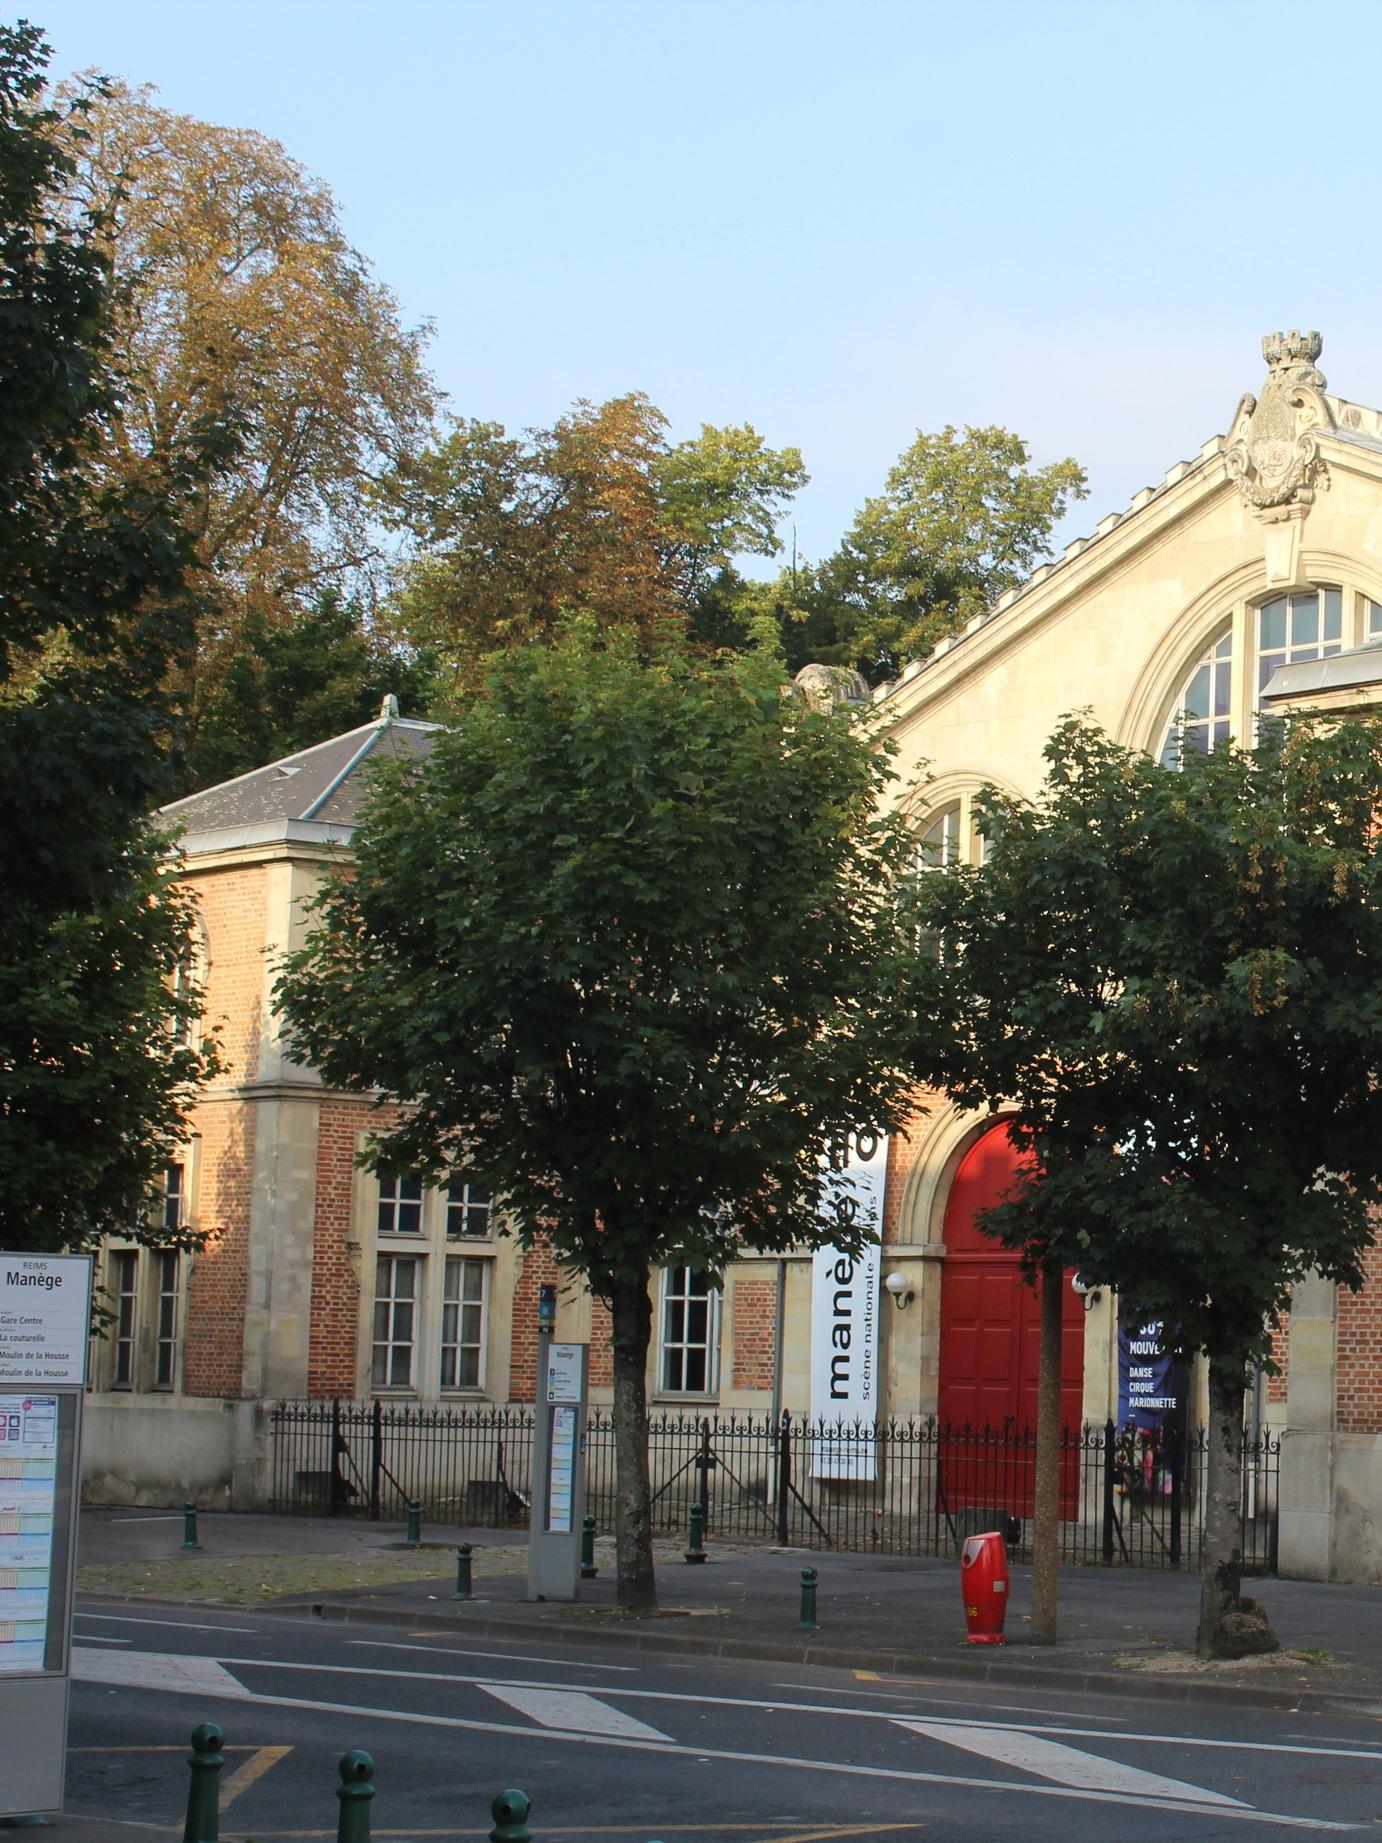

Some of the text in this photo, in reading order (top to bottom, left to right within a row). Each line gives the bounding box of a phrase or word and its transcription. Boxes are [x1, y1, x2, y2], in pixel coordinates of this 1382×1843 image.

[23, 1261, 48, 1271] REIMS
[6, 1271, 63, 1290] Manège
[864, 1262, 875, 1343] nationale
[1, 1315, 43, 1326] Gare Centre
[0, 1351, 70, 1361] Moulin de la Housse
[24, 1369, 34, 1377] de
[35, 1369, 42, 1377] la
[44, 1369, 69, 1378] Housse
[861, 1349, 872, 1400] scène
[1129, 1366, 1153, 1378] DANSE
[1129, 1382, 1155, 1394] CIRQUE
[1128, 1397, 1177, 1409] MARIONNETTE
